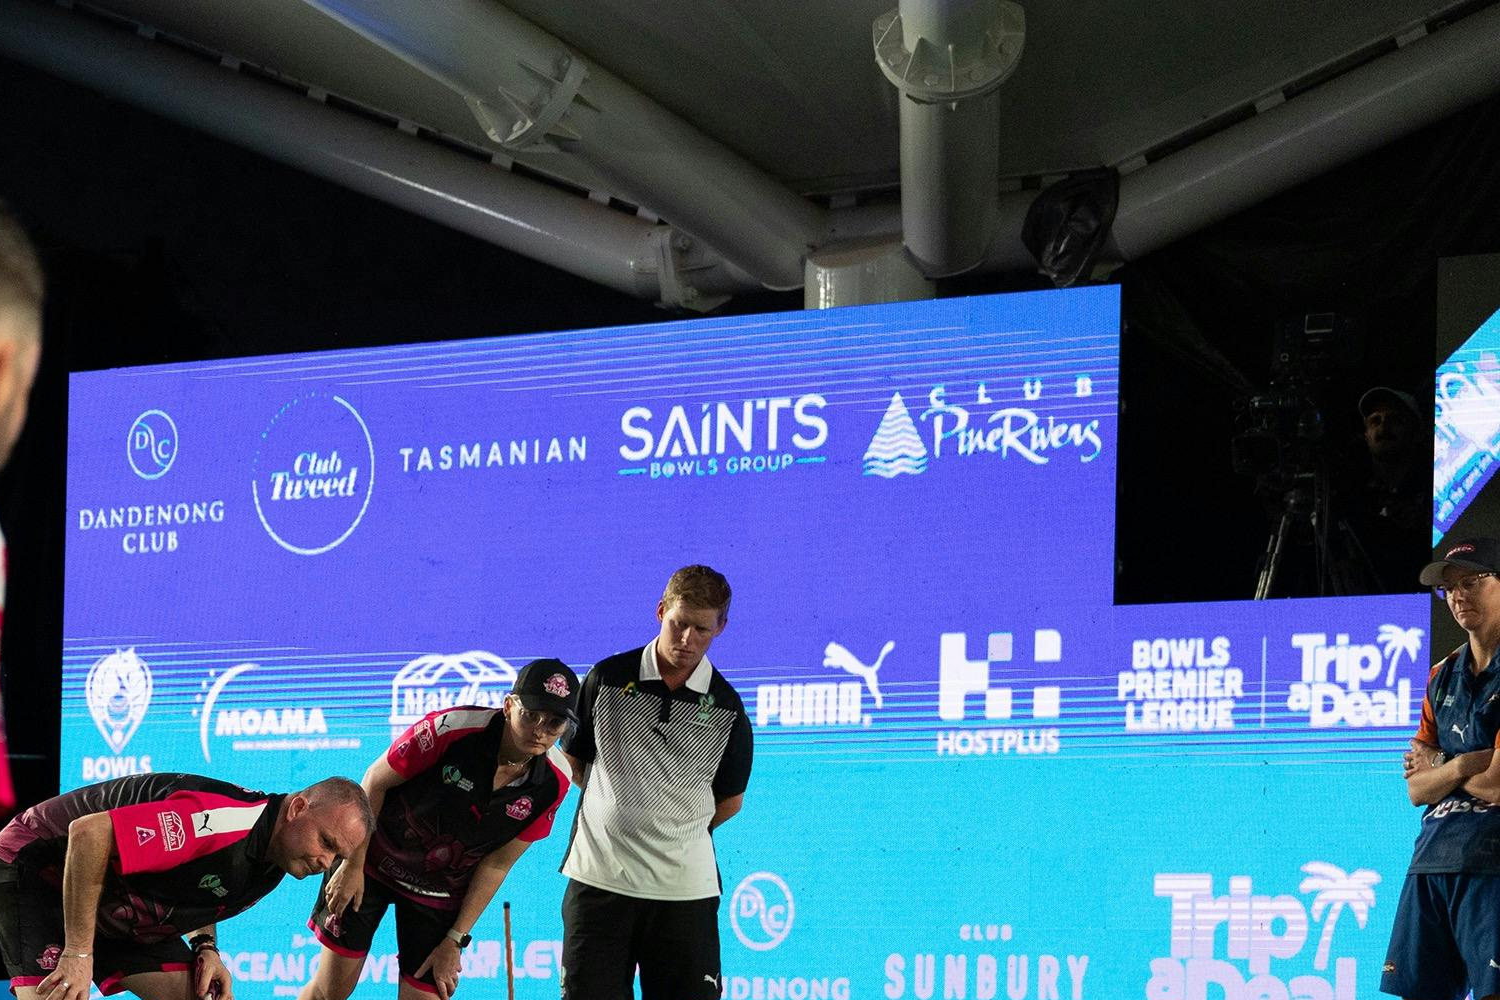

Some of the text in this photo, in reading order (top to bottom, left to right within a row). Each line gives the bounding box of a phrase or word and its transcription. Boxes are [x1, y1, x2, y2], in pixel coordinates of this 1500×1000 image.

[294, 451, 342, 478] Club
[400, 437, 588, 472] TASMANIAN
[650, 453, 794, 479] BOWLS GROUP
[270, 467, 358, 501] Tweed
[79, 501, 225, 530] DANDENONG
[123, 531, 179, 554] CLUB
[1132, 637, 1231, 669] BOWLS
[1292, 633, 1382, 690] Trip
[1117, 667, 1243, 702] PREMIER
[756, 682, 862, 727] PUMA
[1125, 699, 1235, 732] LEAGUE
[215, 708, 328, 737] MOAMA
[937, 729, 1060, 756] HOSTPLUS
[82, 756, 152, 780] BOWLS
[959, 924, 1013, 942] CLUB
[1154, 873, 1308, 975] Trip
[221, 951, 306, 982] OCEAN
